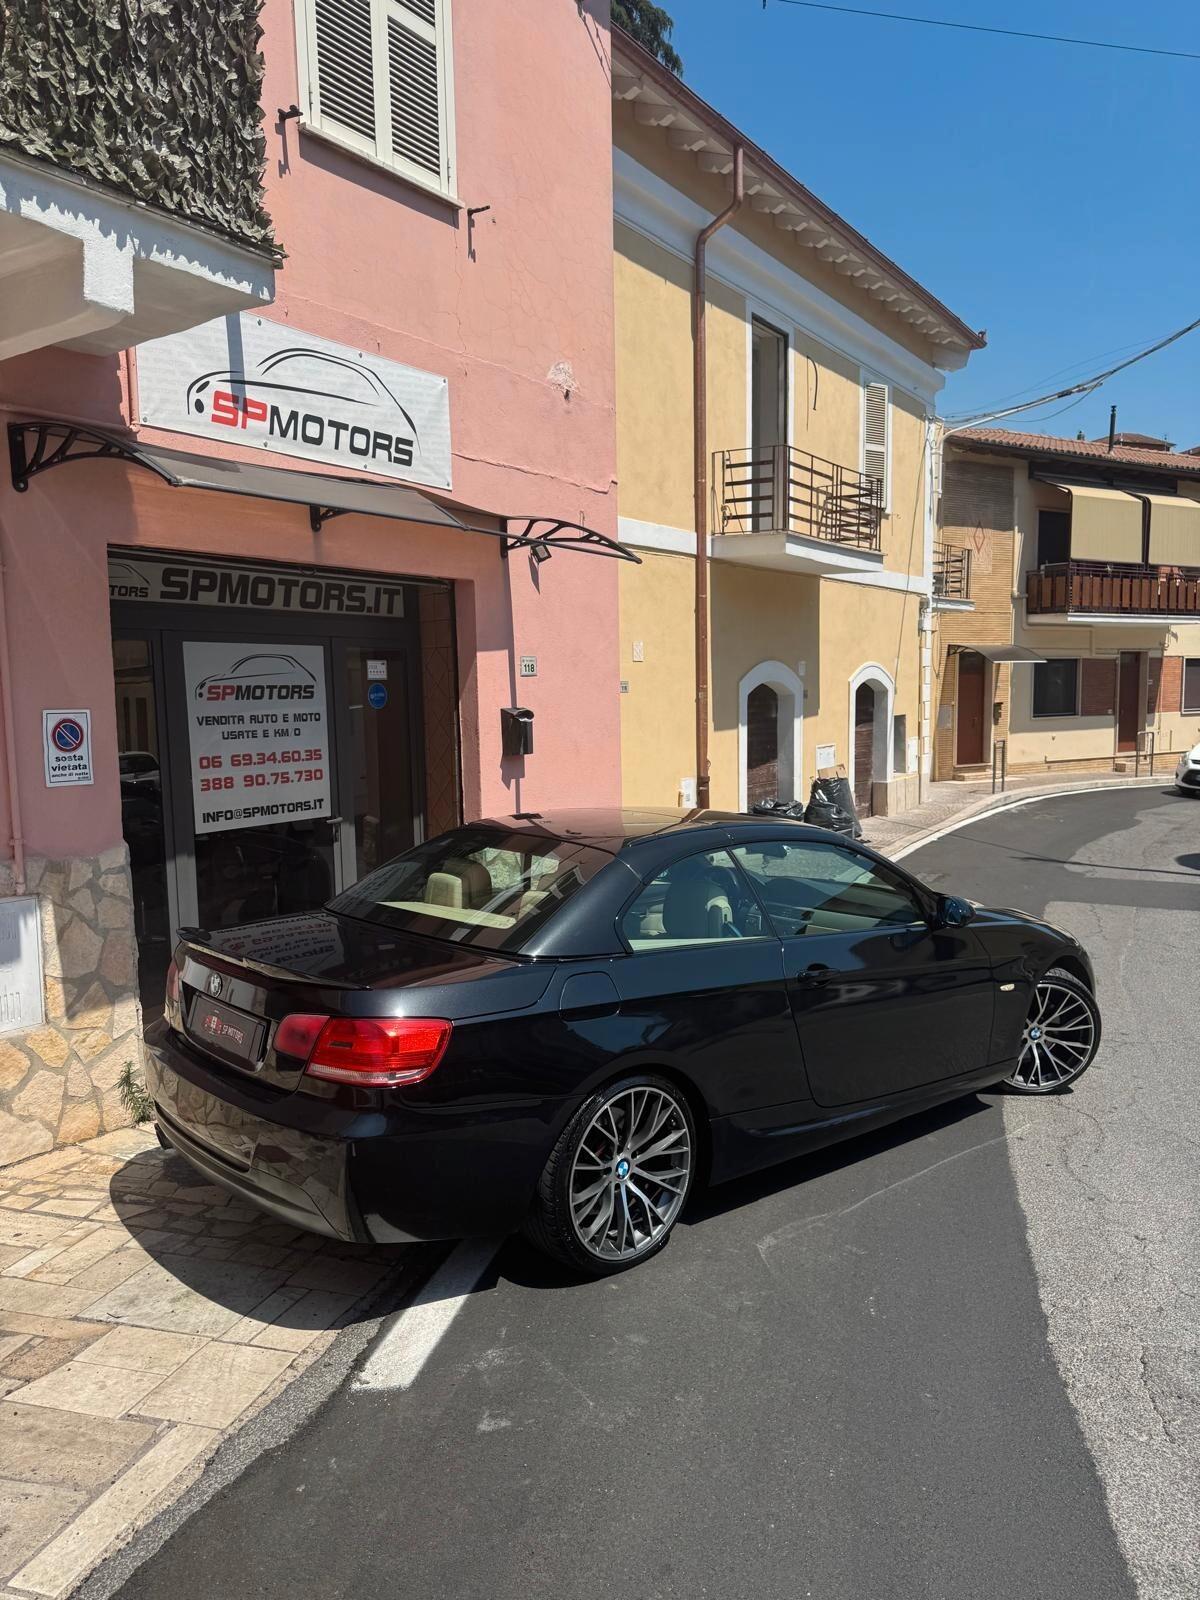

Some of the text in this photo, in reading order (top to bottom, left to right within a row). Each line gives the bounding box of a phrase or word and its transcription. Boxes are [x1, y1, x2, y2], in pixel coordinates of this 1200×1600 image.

[211, 390, 414, 467] SPMOTORS
[160, 567, 401, 615] SPMOTORS.IT
[524, 663, 535, 673] 118
[206, 684, 315, 701] SPMOTORS
[196, 712, 321, 726] VENDITA AUTO E MOTO
[222, 729, 258, 740] USATE
[262, 729, 270, 738] E
[274, 728, 289, 738] KM
[55, 754, 84, 762] sosta
[198, 748, 322, 769] 06 69.34.60.35
[51, 763, 87, 772] vietata
[200, 768, 323, 792] 388 90.75.730
[202, 798, 325, 823] INFO@SPMOTORS.IT
